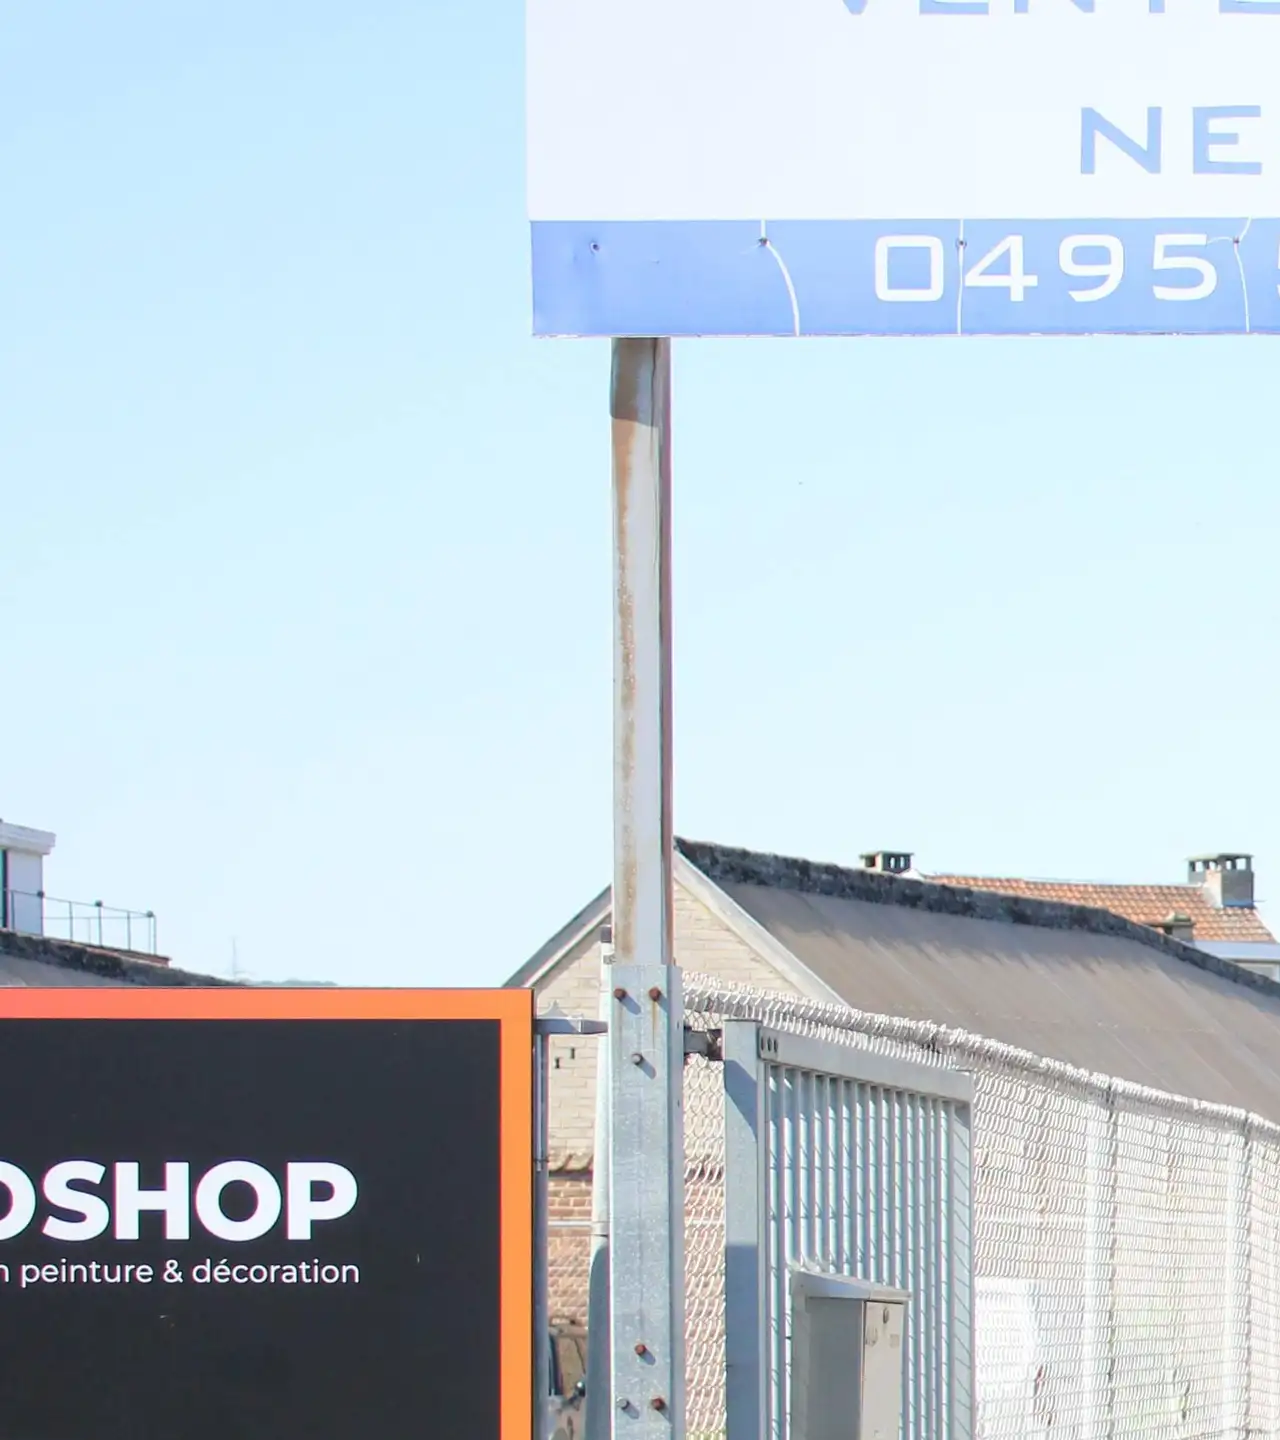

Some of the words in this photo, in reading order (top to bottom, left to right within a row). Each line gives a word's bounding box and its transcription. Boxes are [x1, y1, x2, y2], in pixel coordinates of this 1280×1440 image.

[873, 233, 1218, 303] 0495
[21, 1259, 154, 1288] peinture
[163, 1260, 184, 1284] &
[192, 1258, 360, 1285] décoration
